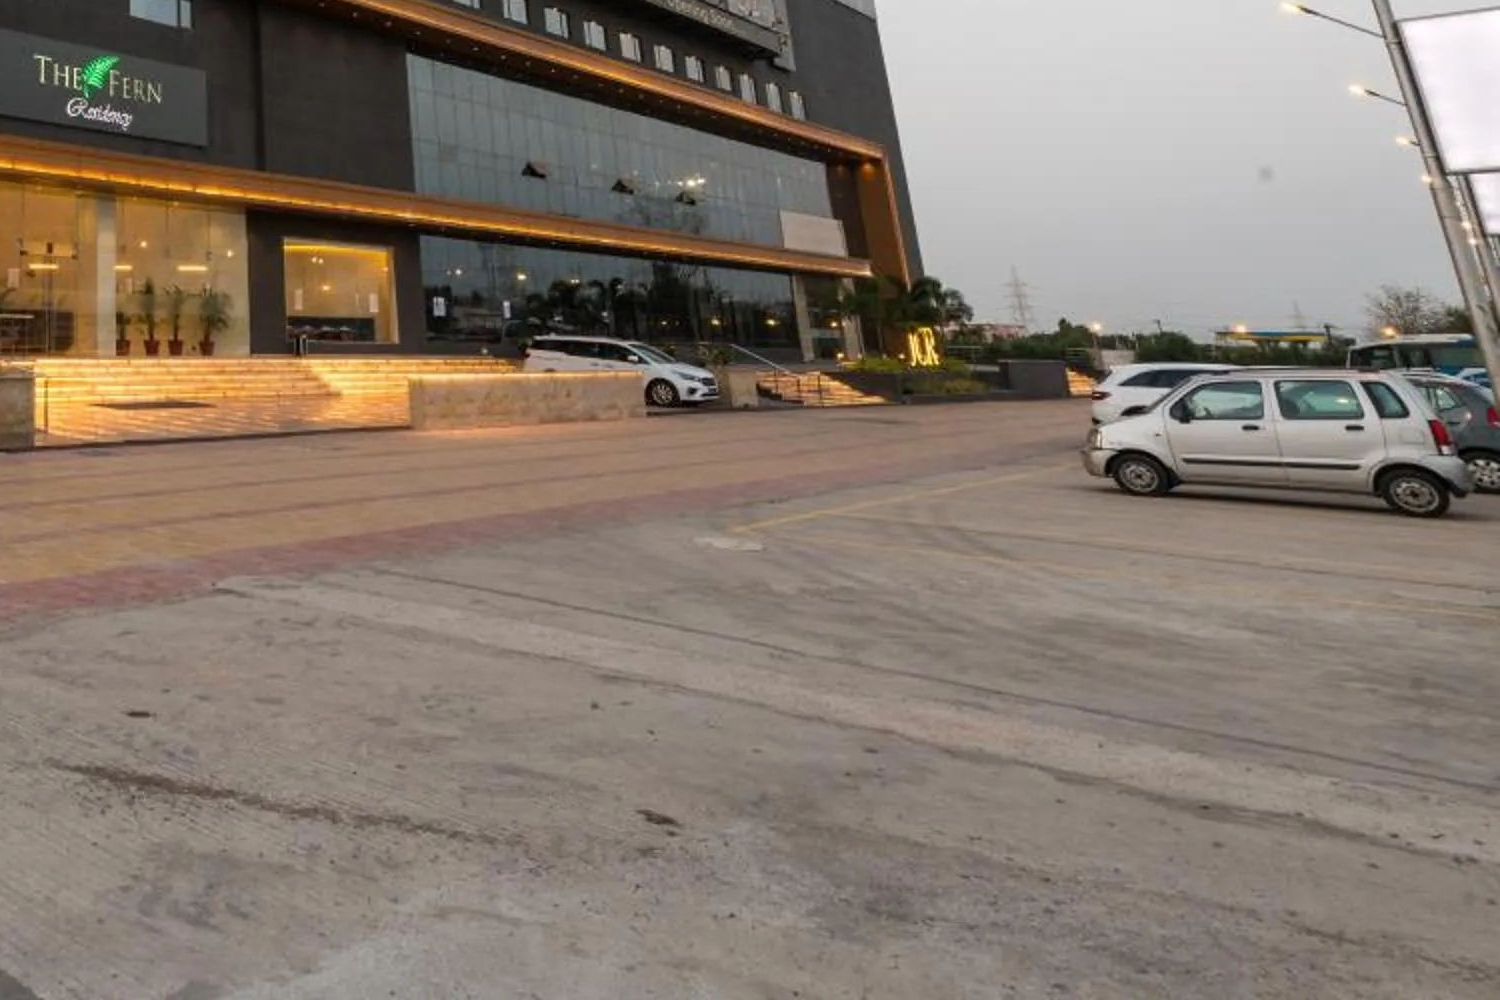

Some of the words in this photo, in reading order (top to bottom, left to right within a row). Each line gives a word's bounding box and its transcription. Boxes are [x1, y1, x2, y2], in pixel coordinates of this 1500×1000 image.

[33, 53, 83, 90] THE
[109, 69, 163, 104] FERN
[66, 96, 133, 131] Residency
